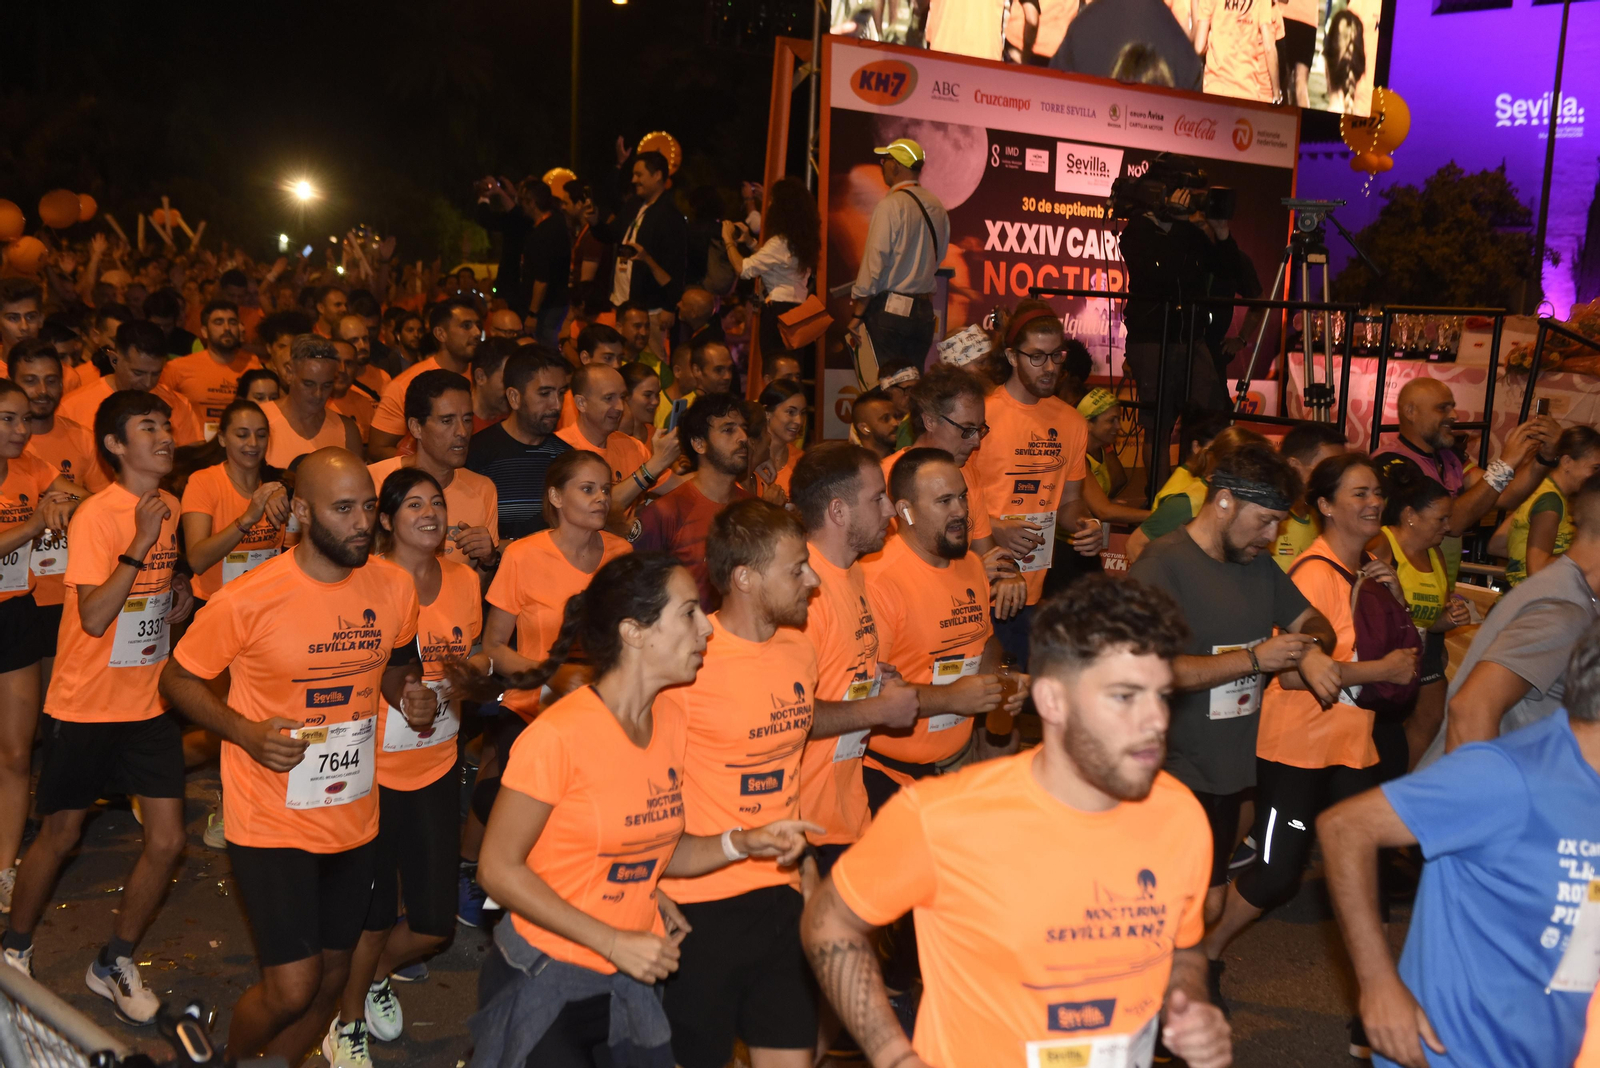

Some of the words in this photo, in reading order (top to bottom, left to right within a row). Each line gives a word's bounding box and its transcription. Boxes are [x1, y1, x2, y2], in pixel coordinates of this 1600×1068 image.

[931, 80, 961, 98] ABC
[974, 89, 1032, 111] Cruzcampo
[1040, 101, 1066, 114] TORRE
[1066, 105, 1096, 119] SEVILLA
[1148, 110, 1164, 121] Avisa
[1005, 146, 1019, 156] IMD
[1022, 197, 1036, 212] 30
[1038, 199, 1052, 213] de
[1054, 202, 1113, 220] septiemb
[984, 220, 1064, 256] XXXIV
[984, 260, 1130, 304] NOCTUR
[1015, 448, 1042, 456] SEVILLA
[35, 536, 68, 552] 2903
[2, 552, 19, 566] 00
[1413, 592, 1439, 603] RUNNERS
[951, 604, 982, 615] NOCTURNA
[138, 617, 165, 637] 3337
[940, 617, 967, 629] SEVILLA
[332, 630, 382, 640] NOCTURNA
[308, 640, 356, 654] SEVILLA
[313, 691, 344, 703] Sevilla.
[435, 700, 450, 718] 47
[770, 705, 812, 722] NOCTURNA
[748, 721, 791, 739] SEVILLA
[319, 749, 360, 773] 7644
[625, 810, 668, 826] SEVILLA
[1557, 838, 1577, 856] IX
[1086, 904, 1167, 920] NOCTURNA
[1046, 926, 1121, 942] SEVILLA
